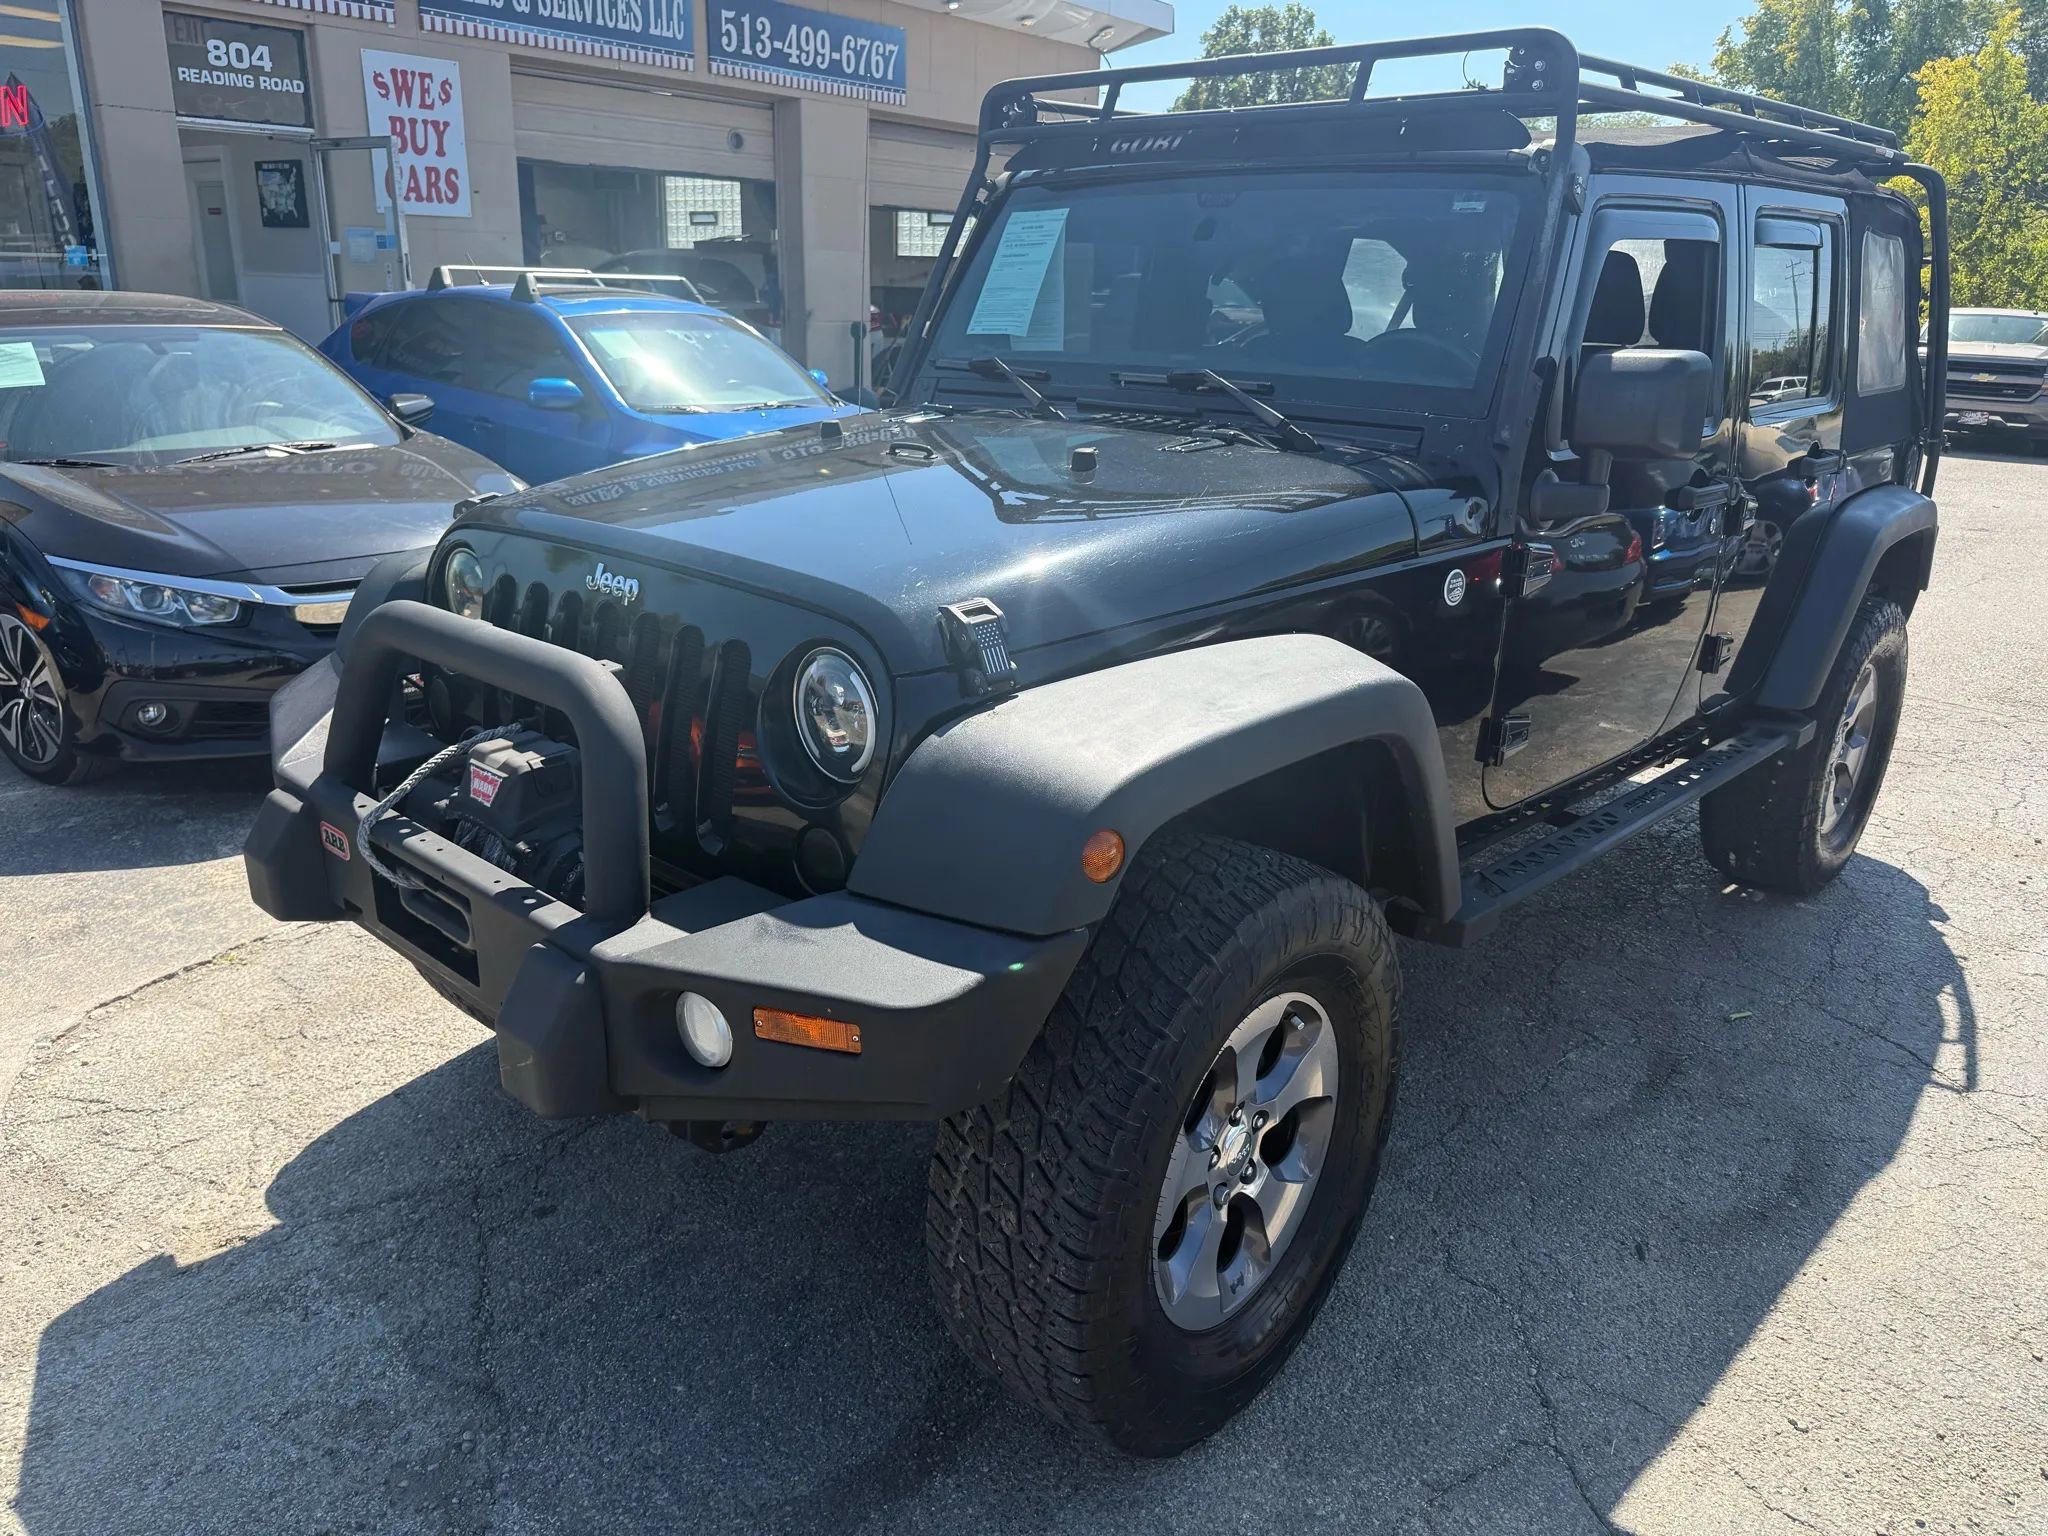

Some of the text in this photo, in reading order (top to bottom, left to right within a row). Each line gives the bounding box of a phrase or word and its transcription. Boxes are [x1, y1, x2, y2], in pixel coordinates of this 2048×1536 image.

[649, 0, 685, 40] LLC
[206, 39, 273, 72] 804
[721, 9, 899, 80] 513-499-6767
[177, 67, 305, 94] READING ROAD
[389, 115, 450, 157] BUY
[586, 562, 640, 607] Jeep
[473, 777, 495, 796] WARN
[323, 828, 347, 854] ARB
